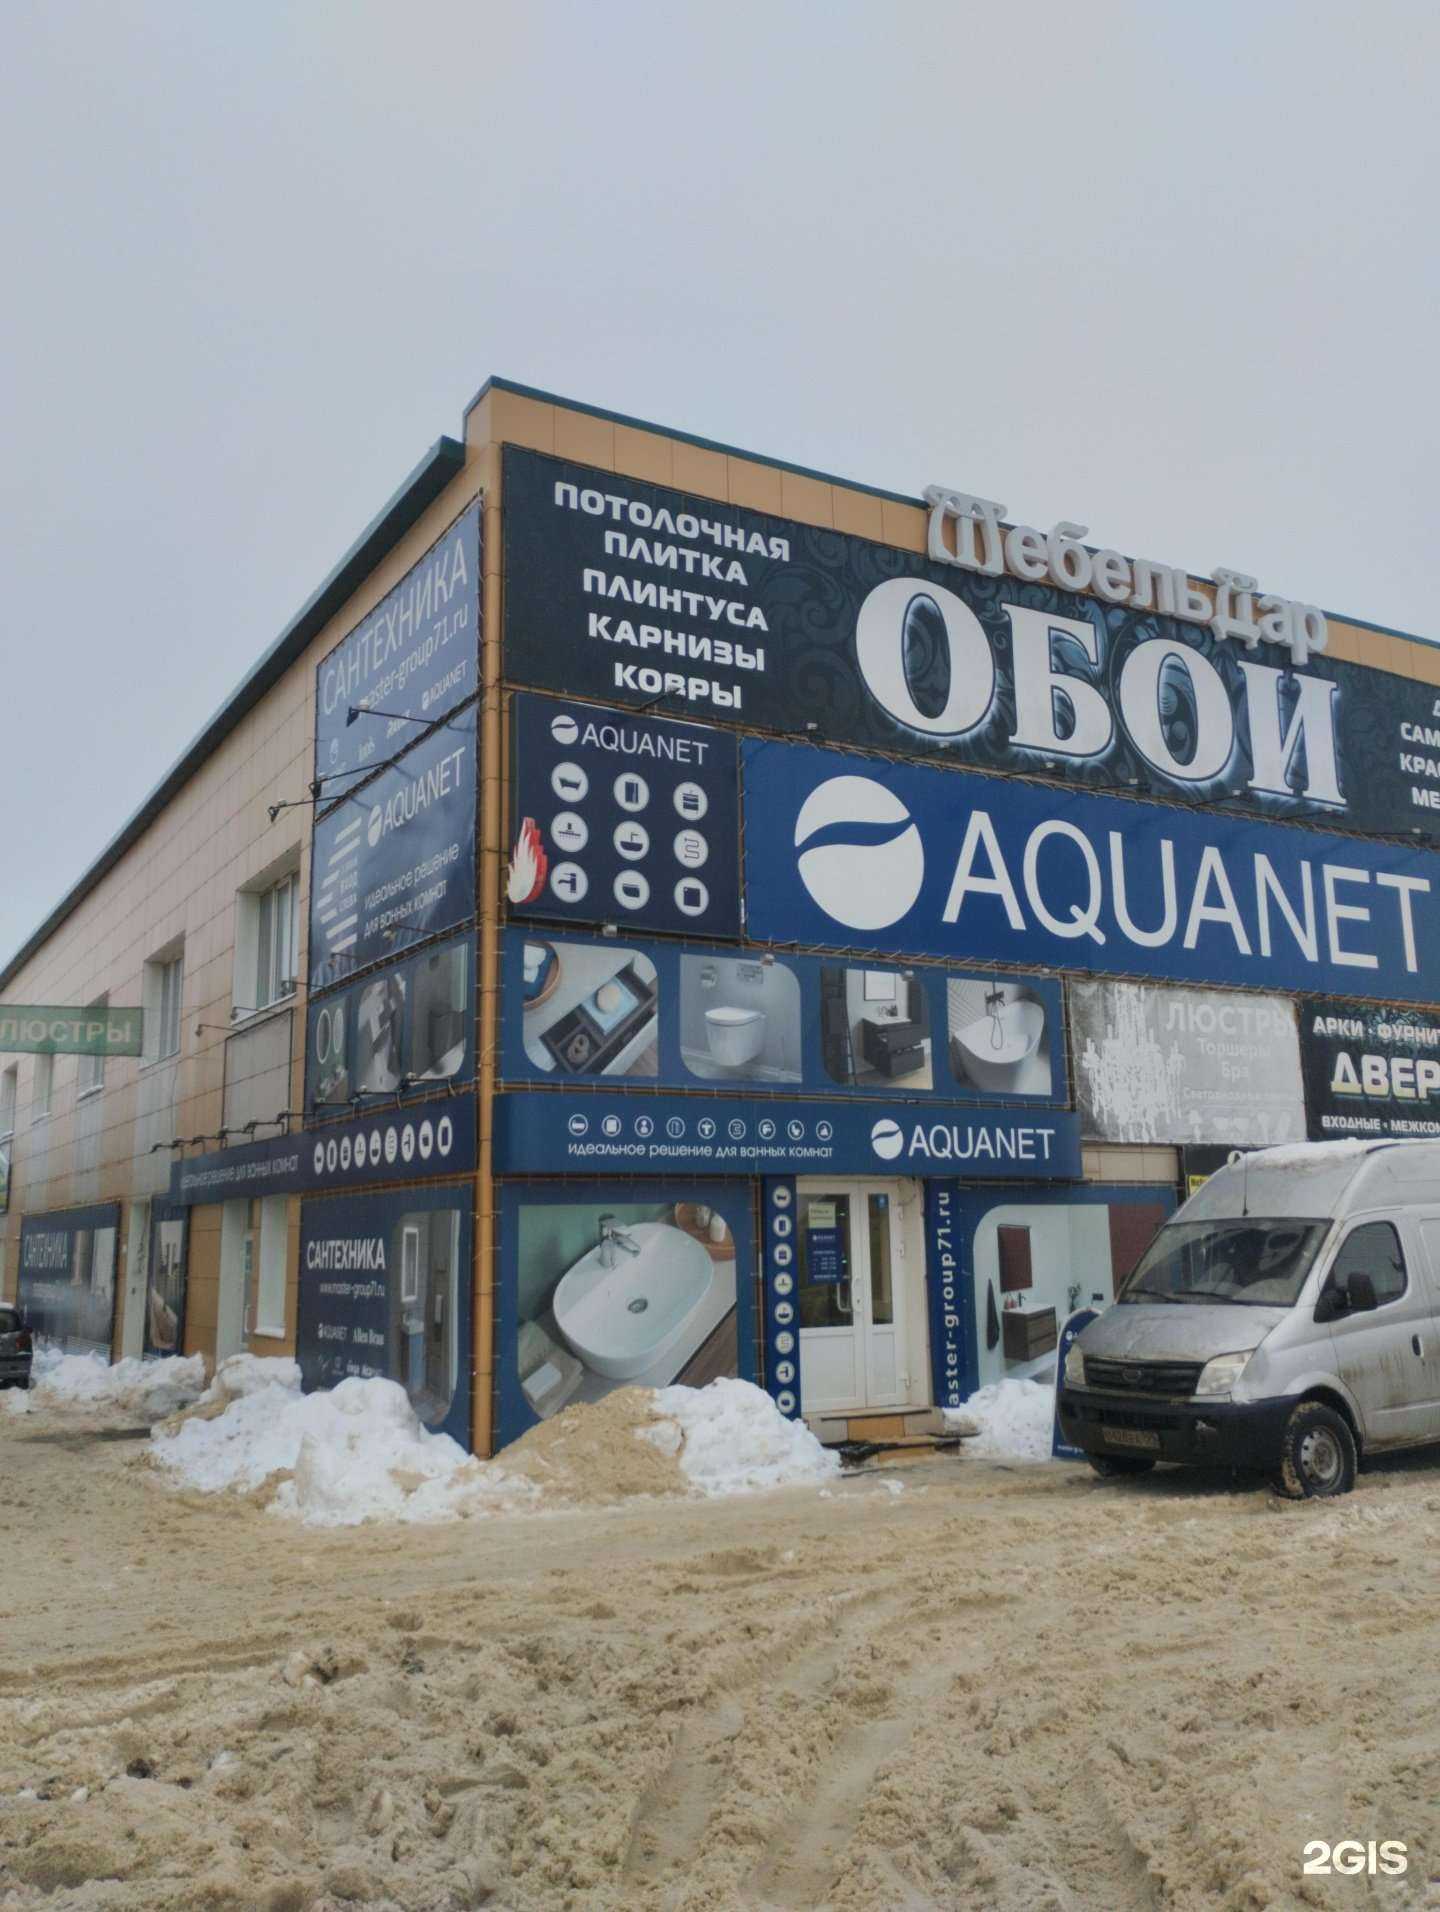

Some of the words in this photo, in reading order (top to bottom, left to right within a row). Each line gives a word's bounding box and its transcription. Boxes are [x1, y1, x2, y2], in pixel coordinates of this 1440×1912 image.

[554, 480, 790, 562] ПОТОЛОЧНАЯ
[604, 530, 749, 587] ПЛИТКА
[582, 567, 770, 632] ПЛИНТУСА
[322, 537, 469, 716] САНТЕХНИКА
[588, 612, 766, 672] КАРНИЗЫ
[614, 662, 742, 709] КОВРЫ
[856, 576, 1346, 806] ОБОИ
[581, 722, 710, 766] AQUANET
[382, 747, 466, 836] AQUANET
[941, 810, 1431, 974] AQUANET
[0, 1019, 132, 1043] ЛЮСТРЫ
[1165, 1001, 1298, 1038] ЛЮСТРЫ
[1312, 1015, 1364, 1038] АРКИ
[1331, 1051, 1440, 1100] ДВЕР
[908, 1124, 1056, 1161] AQUANET
[1321, 1114, 1381, 1130] ВХОДНЫЕ
[568, 1143, 646, 1156] идеальное
[649, 1143, 713, 1157] решение
[715, 1146, 738, 1158] для
[740, 1145, 786, 1158] ванных
[788, 1147, 833, 1158] комнат
[306, 1237, 387, 1271] САНТЕХНИКА
